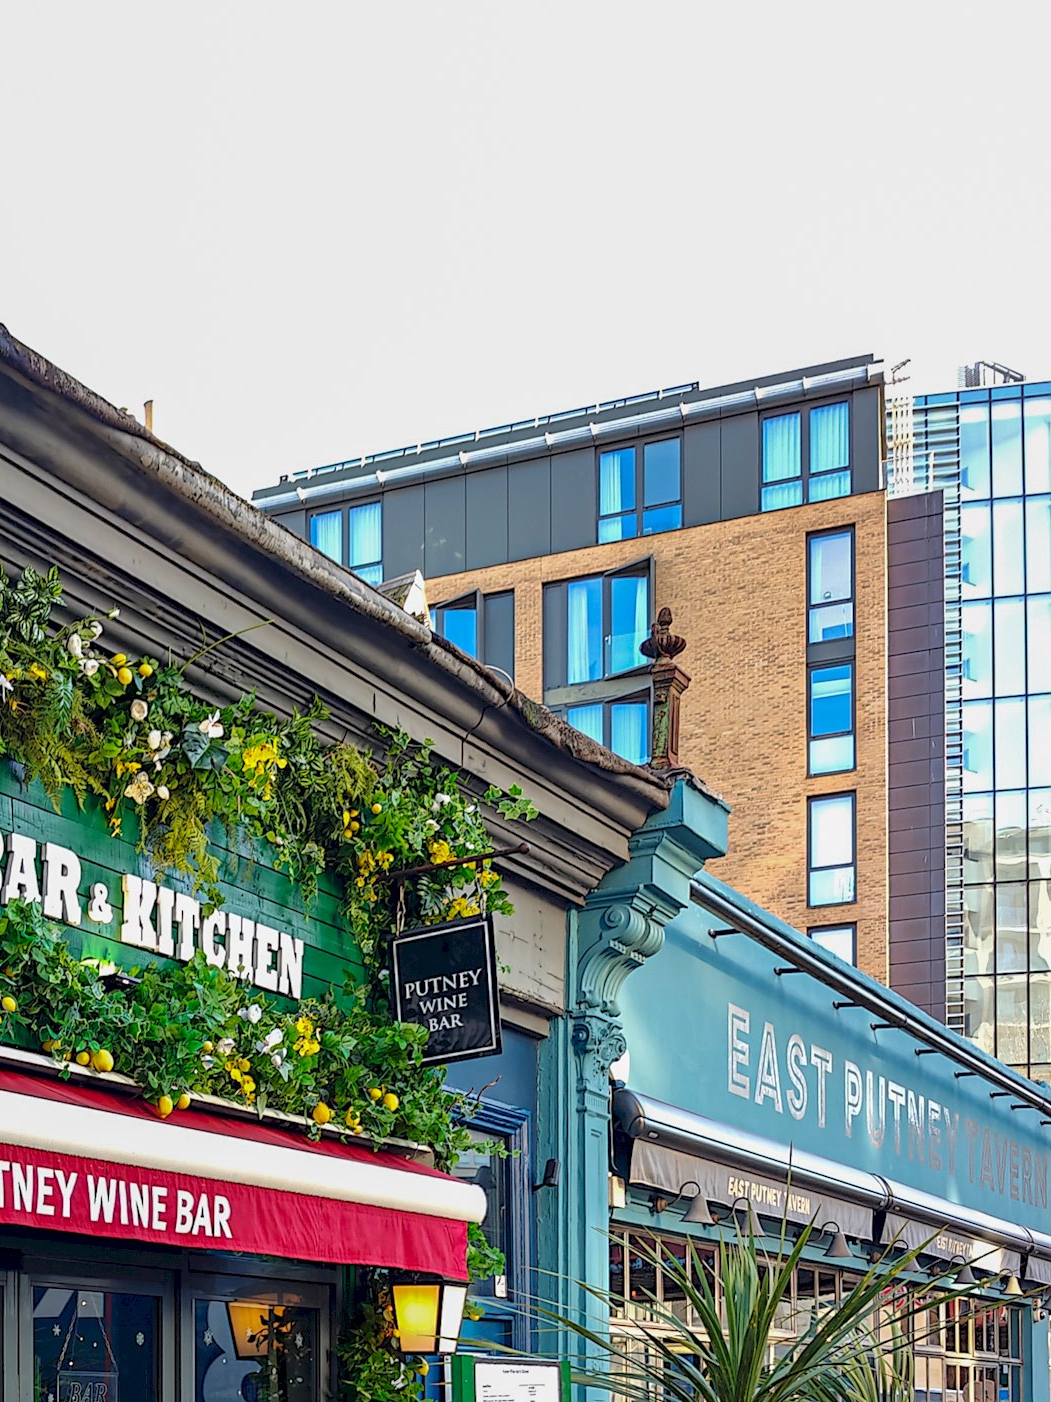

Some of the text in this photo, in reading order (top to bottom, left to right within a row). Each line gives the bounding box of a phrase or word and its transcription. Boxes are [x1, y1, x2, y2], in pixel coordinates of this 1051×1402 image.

[88, 882, 113, 924] &
[121, 874, 304, 1000] KITCHEN
[404, 968, 482, 999] PUTNEY
[419, 992, 468, 1014] WINE
[428, 1013, 464, 1033] BAR
[727, 1002, 1048, 1210] EAST PUTNEY TAVERN
[87, 1174, 168, 1231] WINE
[175, 1189, 233, 1239] BAR
[728, 1176, 750, 1198] EAST
[751, 1182, 782, 1207] PUTNEY
